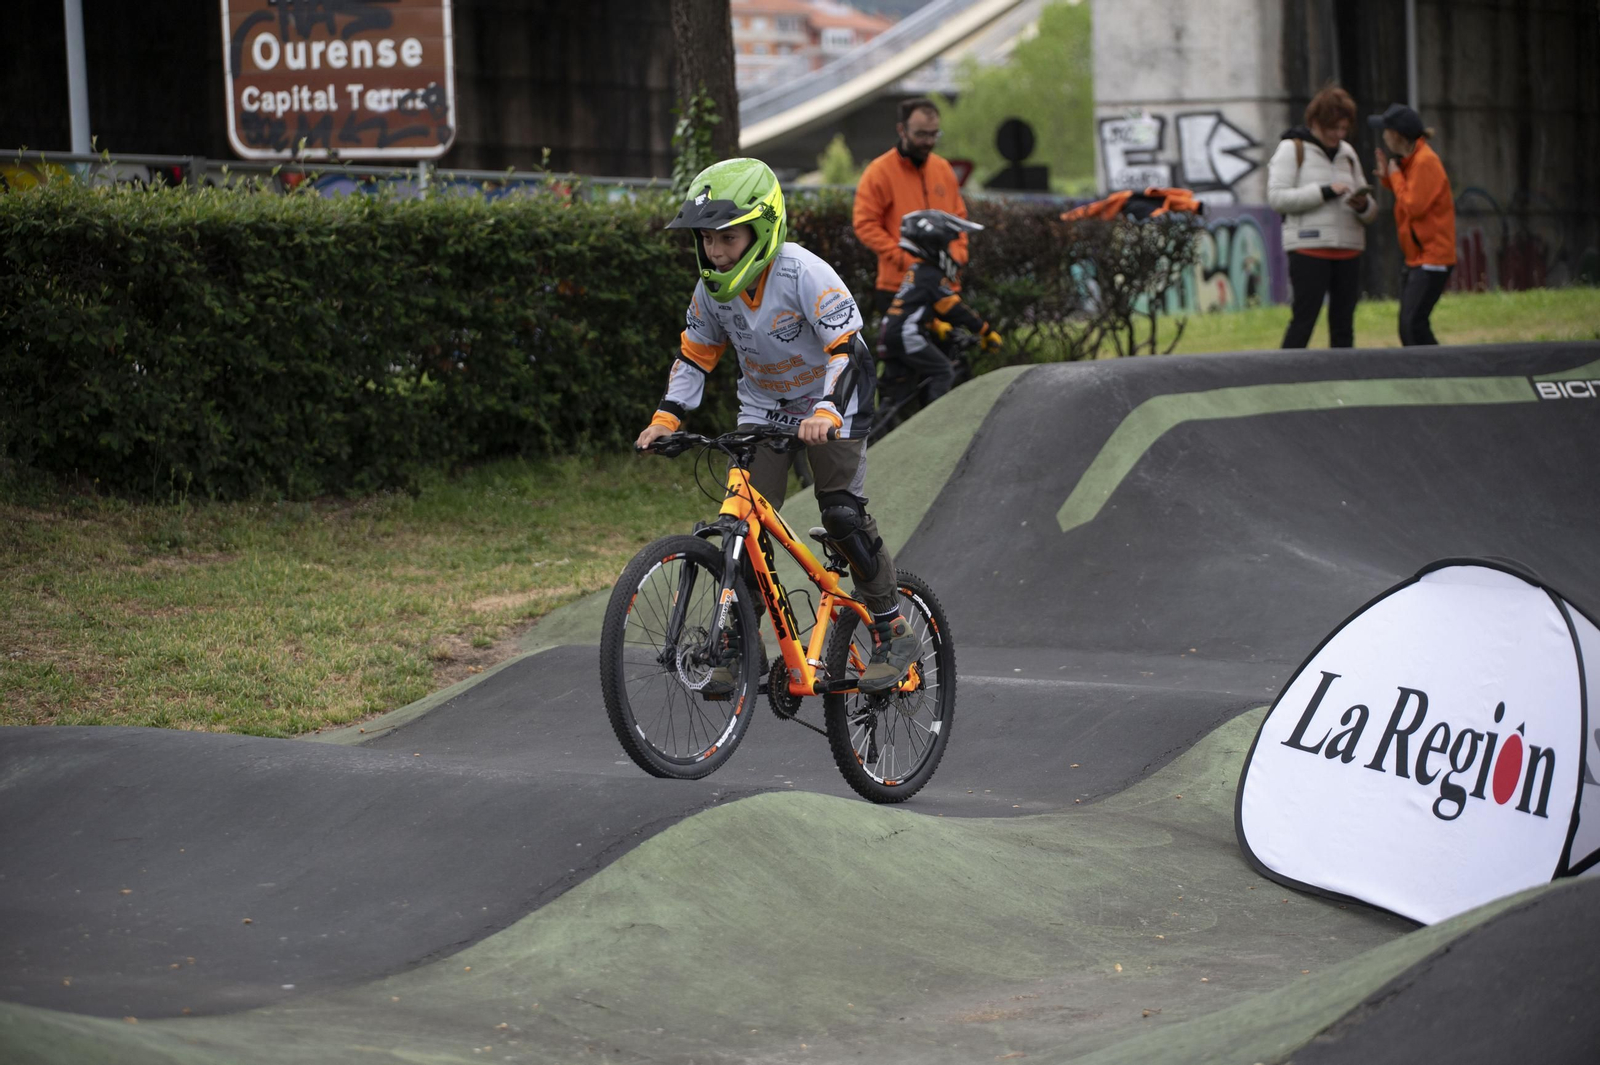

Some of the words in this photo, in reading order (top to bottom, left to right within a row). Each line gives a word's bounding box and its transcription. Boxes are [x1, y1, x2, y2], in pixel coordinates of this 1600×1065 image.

[252, 31, 423, 71] Ourense
[241, 83, 338, 118] Capital
[827, 311, 848, 323] TEAM
[1280, 670, 1369, 764] La
[1363, 686, 1556, 821] Región
